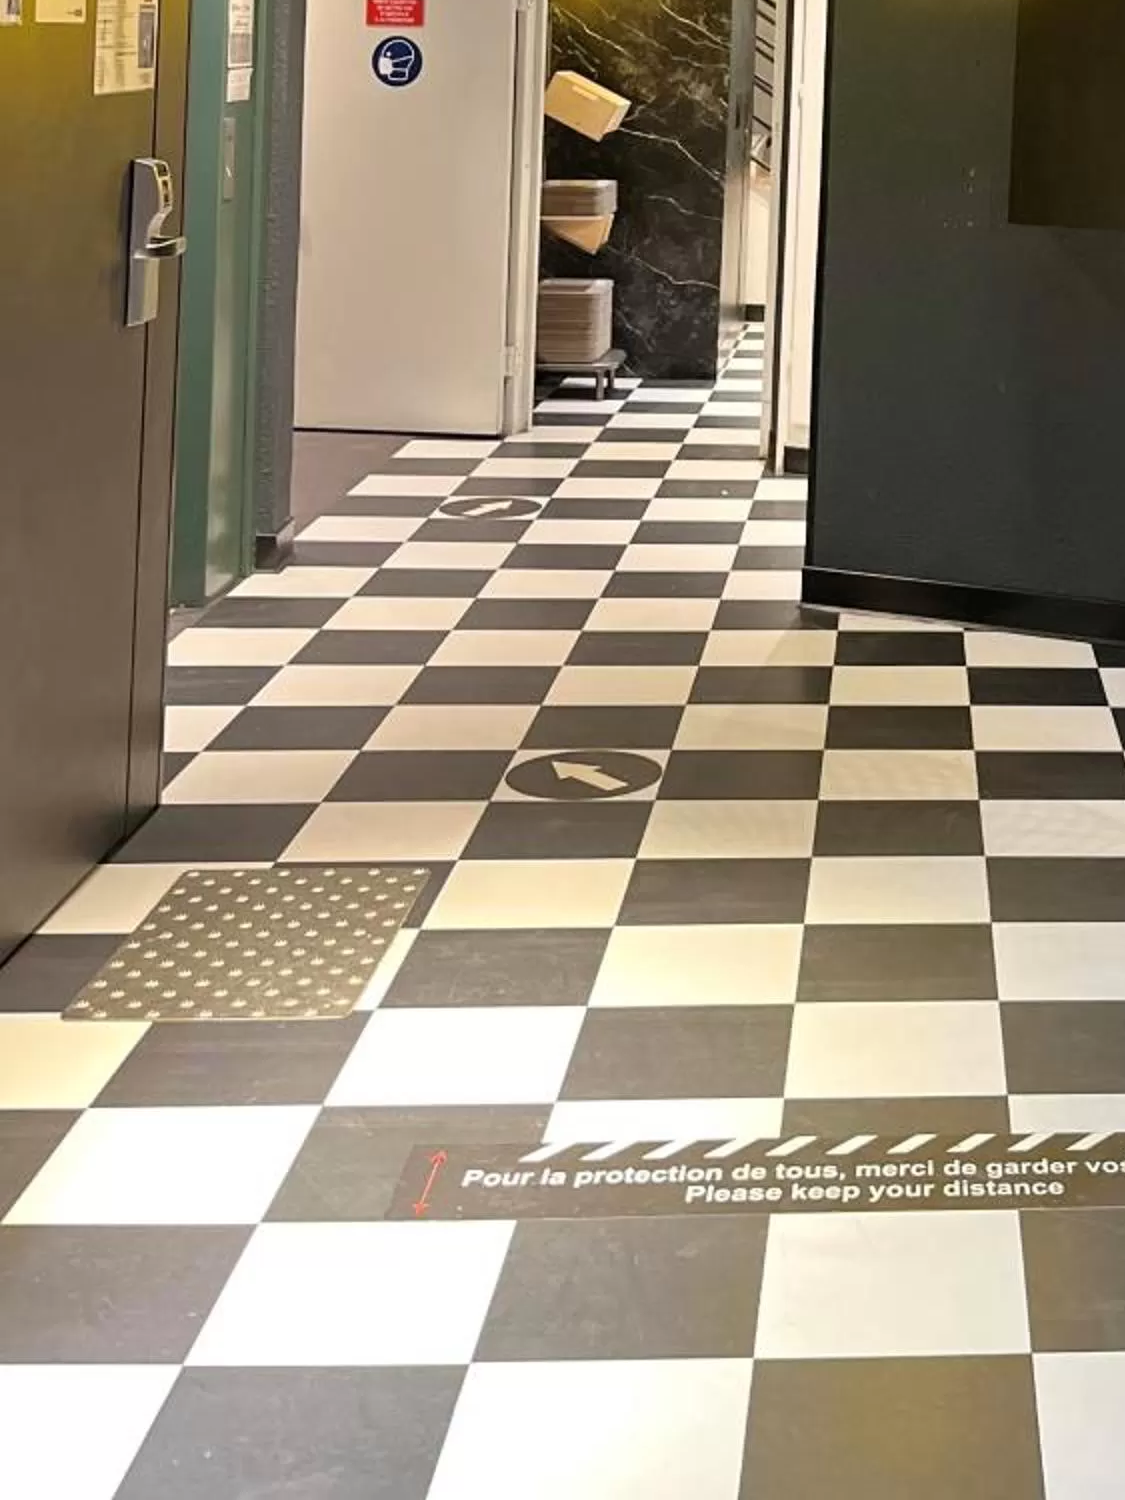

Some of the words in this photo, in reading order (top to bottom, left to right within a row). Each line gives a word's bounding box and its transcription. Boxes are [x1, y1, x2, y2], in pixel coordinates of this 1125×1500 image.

[462, 1168, 533, 1188] Pour
[541, 1168, 566, 1186] la
[574, 1164, 726, 1187] protection
[732, 1163, 766, 1181] de
[776, 1163, 846, 1182] tous,
[855, 1160, 934, 1179] merci
[945, 1159, 978, 1177] de
[986, 1158, 1077, 1179] garder
[685, 1184, 783, 1204] Please
[791, 1183, 860, 1205] keep
[869, 1182, 934, 1202] your
[943, 1180, 1065, 1198] distance
